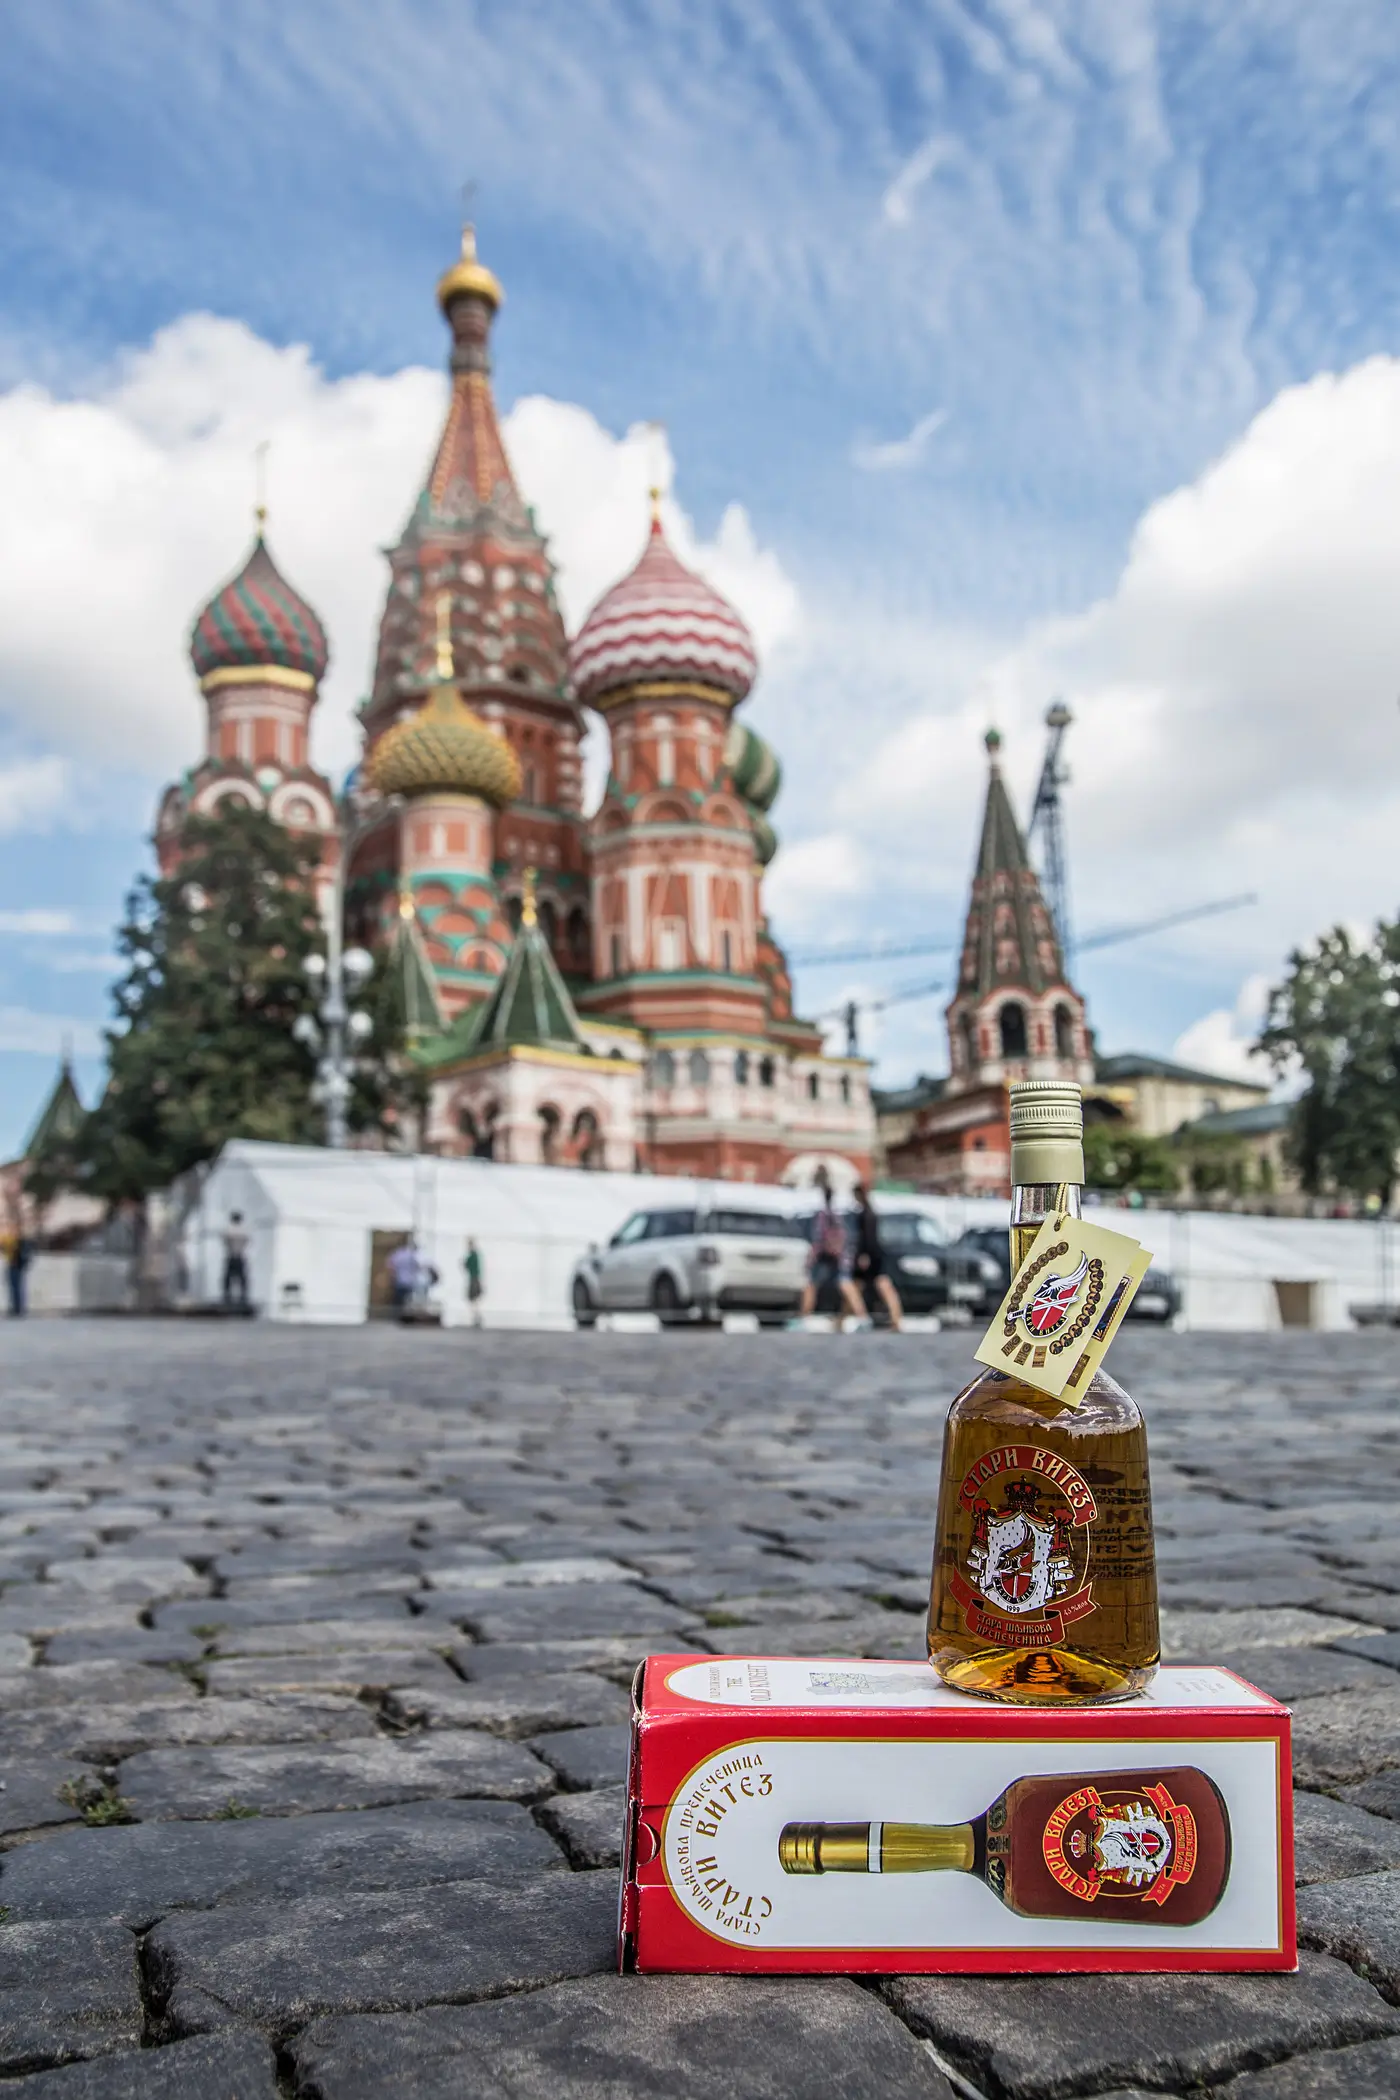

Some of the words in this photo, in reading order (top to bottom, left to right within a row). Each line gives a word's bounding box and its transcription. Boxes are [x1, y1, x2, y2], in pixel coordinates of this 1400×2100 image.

[963, 1448, 1019, 1498] СТАРИ
[1031, 1450, 1092, 1508] ВИТЕЗ
[976, 1614, 1002, 1630] СТАРА
[1006, 1604, 1021, 1613] 1999
[975, 1623, 1052, 1646] ПРЕПЕЧЕНИЦА
[680, 1754, 763, 1828] ПРЕПЕЧЕНИЦА
[695, 1773, 773, 1838] ВИТЕЗ
[1046, 1793, 1088, 1839] ВИТЕЗ
[677, 1835, 714, 1912] ШЉИВОВА
[1046, 1848, 1089, 1896] СТАРИ
[1174, 1851, 1184, 1873] СТАРА
[695, 1856, 773, 1919] СТАРИ
[715, 1908, 761, 1936] СТАРА
